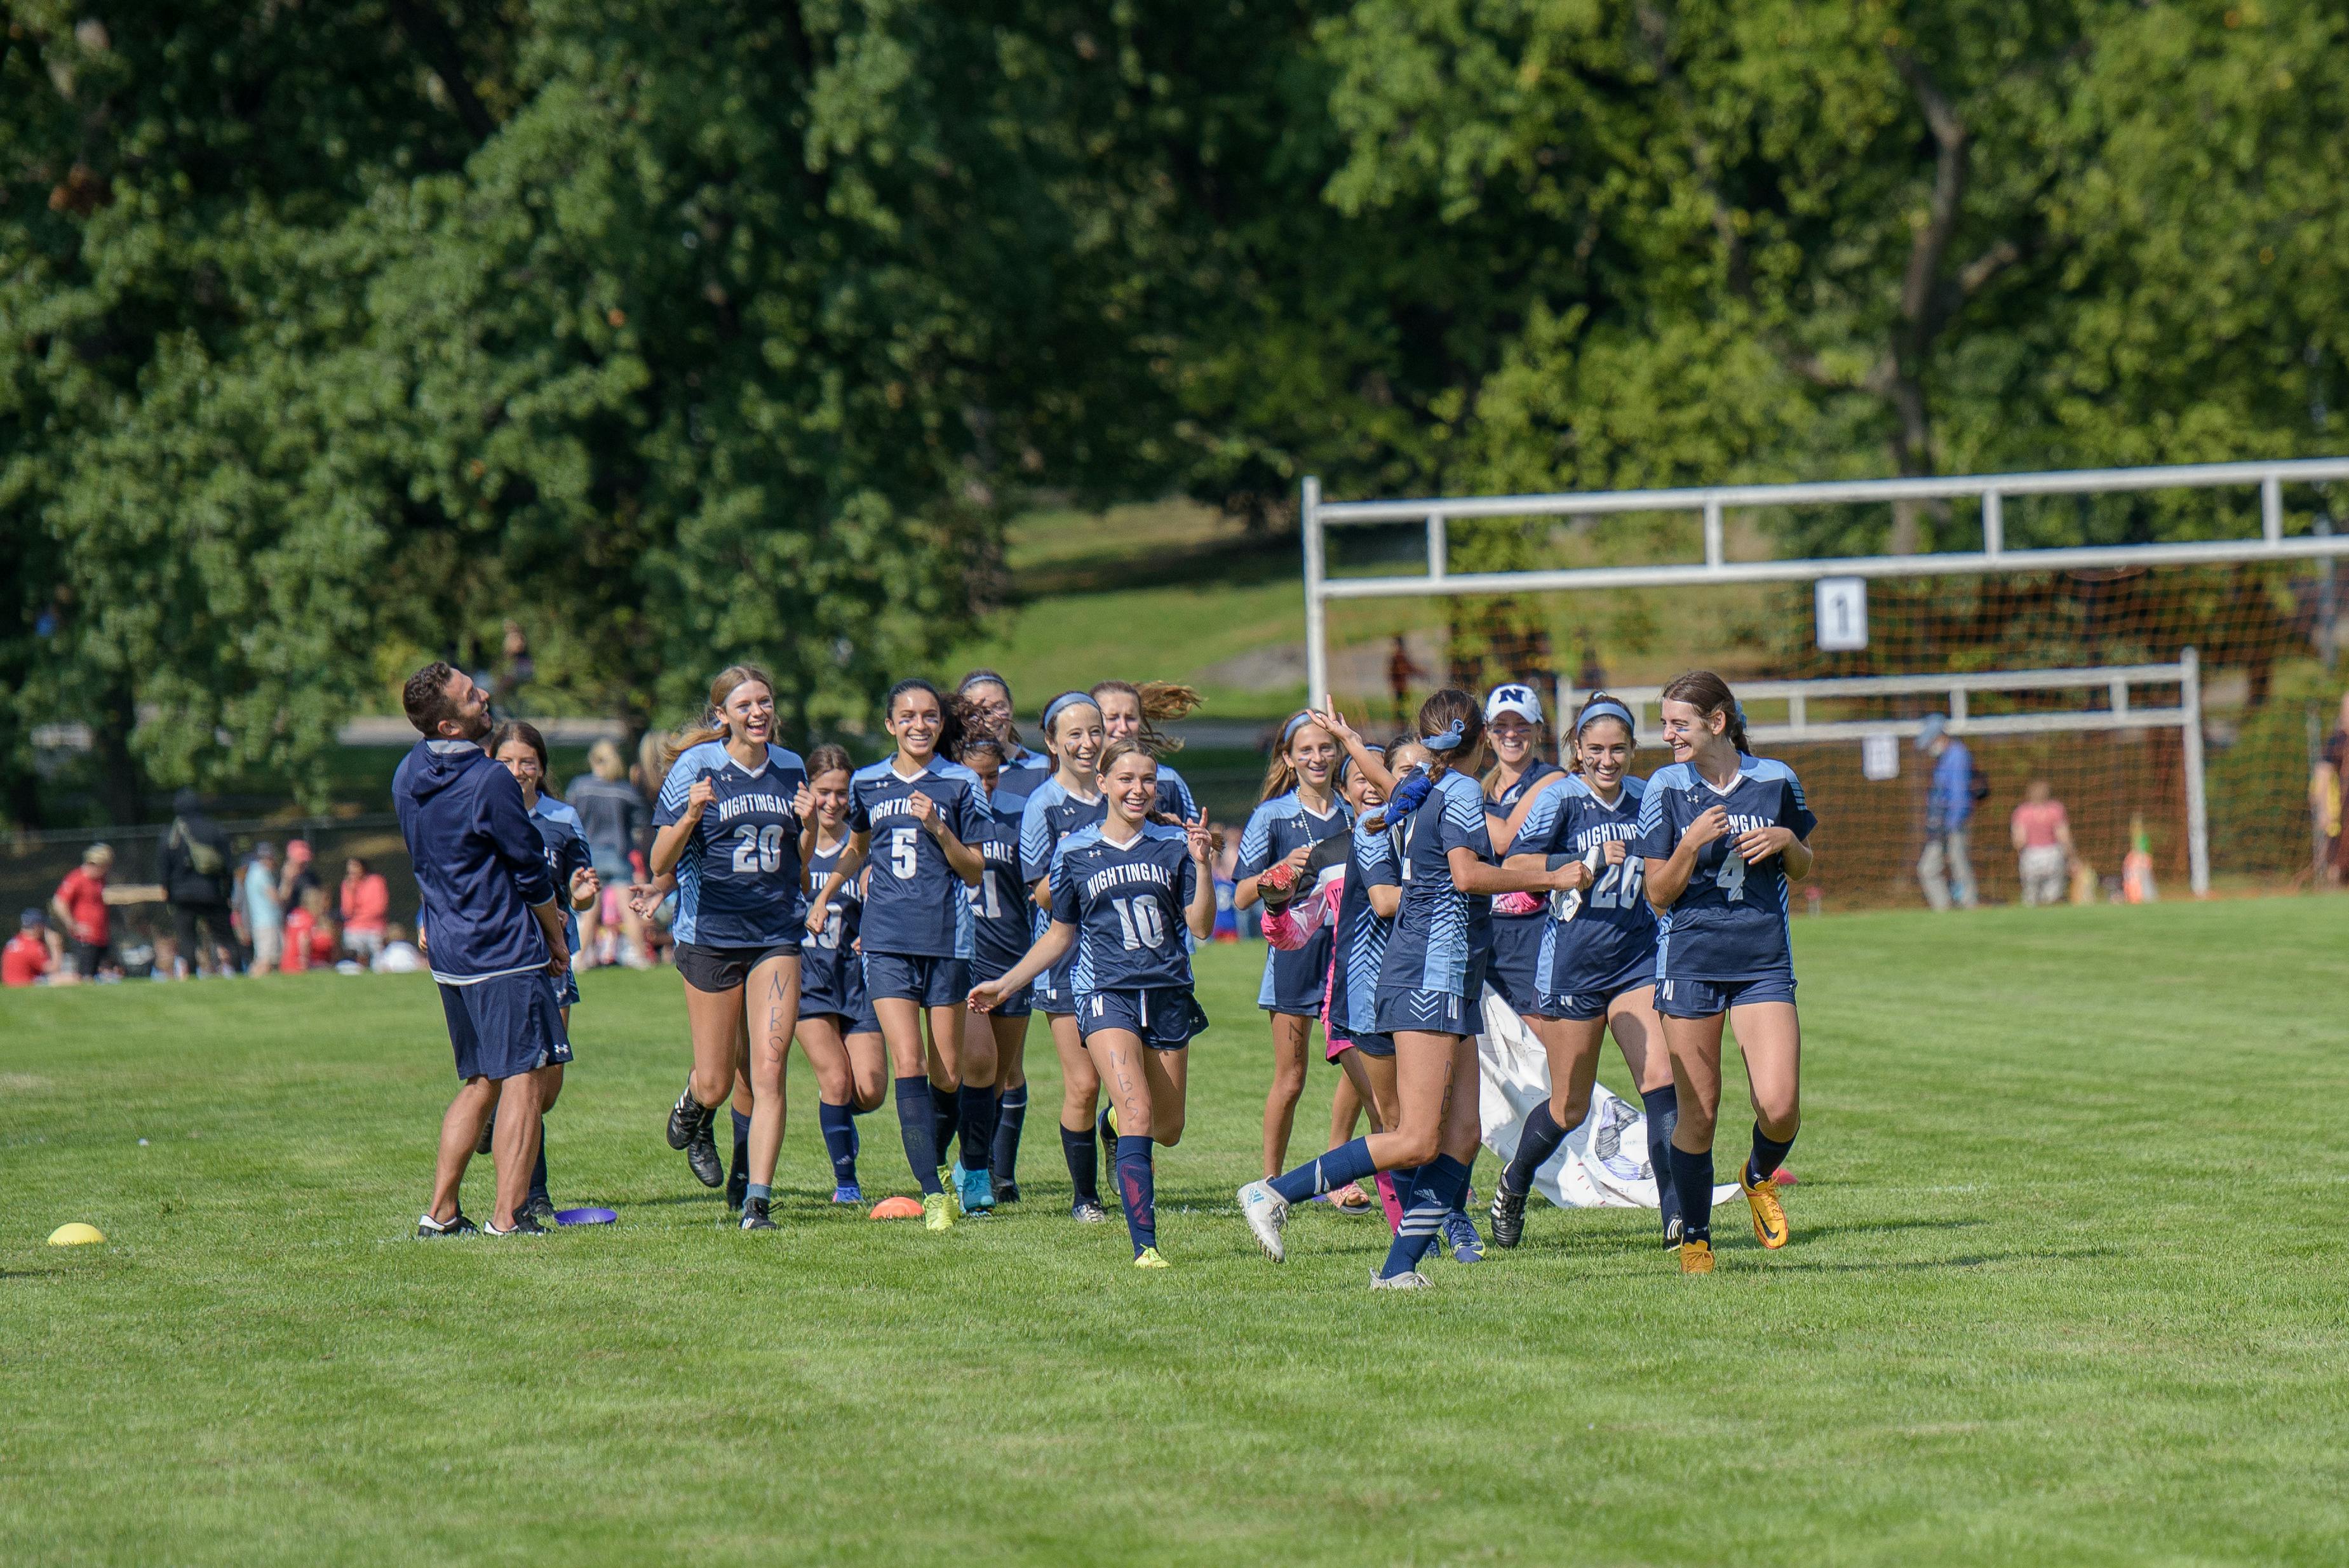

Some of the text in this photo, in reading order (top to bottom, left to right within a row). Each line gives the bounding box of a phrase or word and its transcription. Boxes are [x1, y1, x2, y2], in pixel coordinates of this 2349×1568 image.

[1498, 689, 1525, 704] N
[732, 824, 784, 873] 20
[891, 828, 917, 880] 5
[1577, 822, 1638, 853] NIGHTING
[1087, 862, 1171, 900] NIGHTINGALE
[1591, 855, 1645, 909] 26
[1716, 849, 1746, 902] 4
[1112, 894, 1164, 951] 10
[768, 970, 790, 1063] NBS
[1091, 995, 1104, 1017] N
